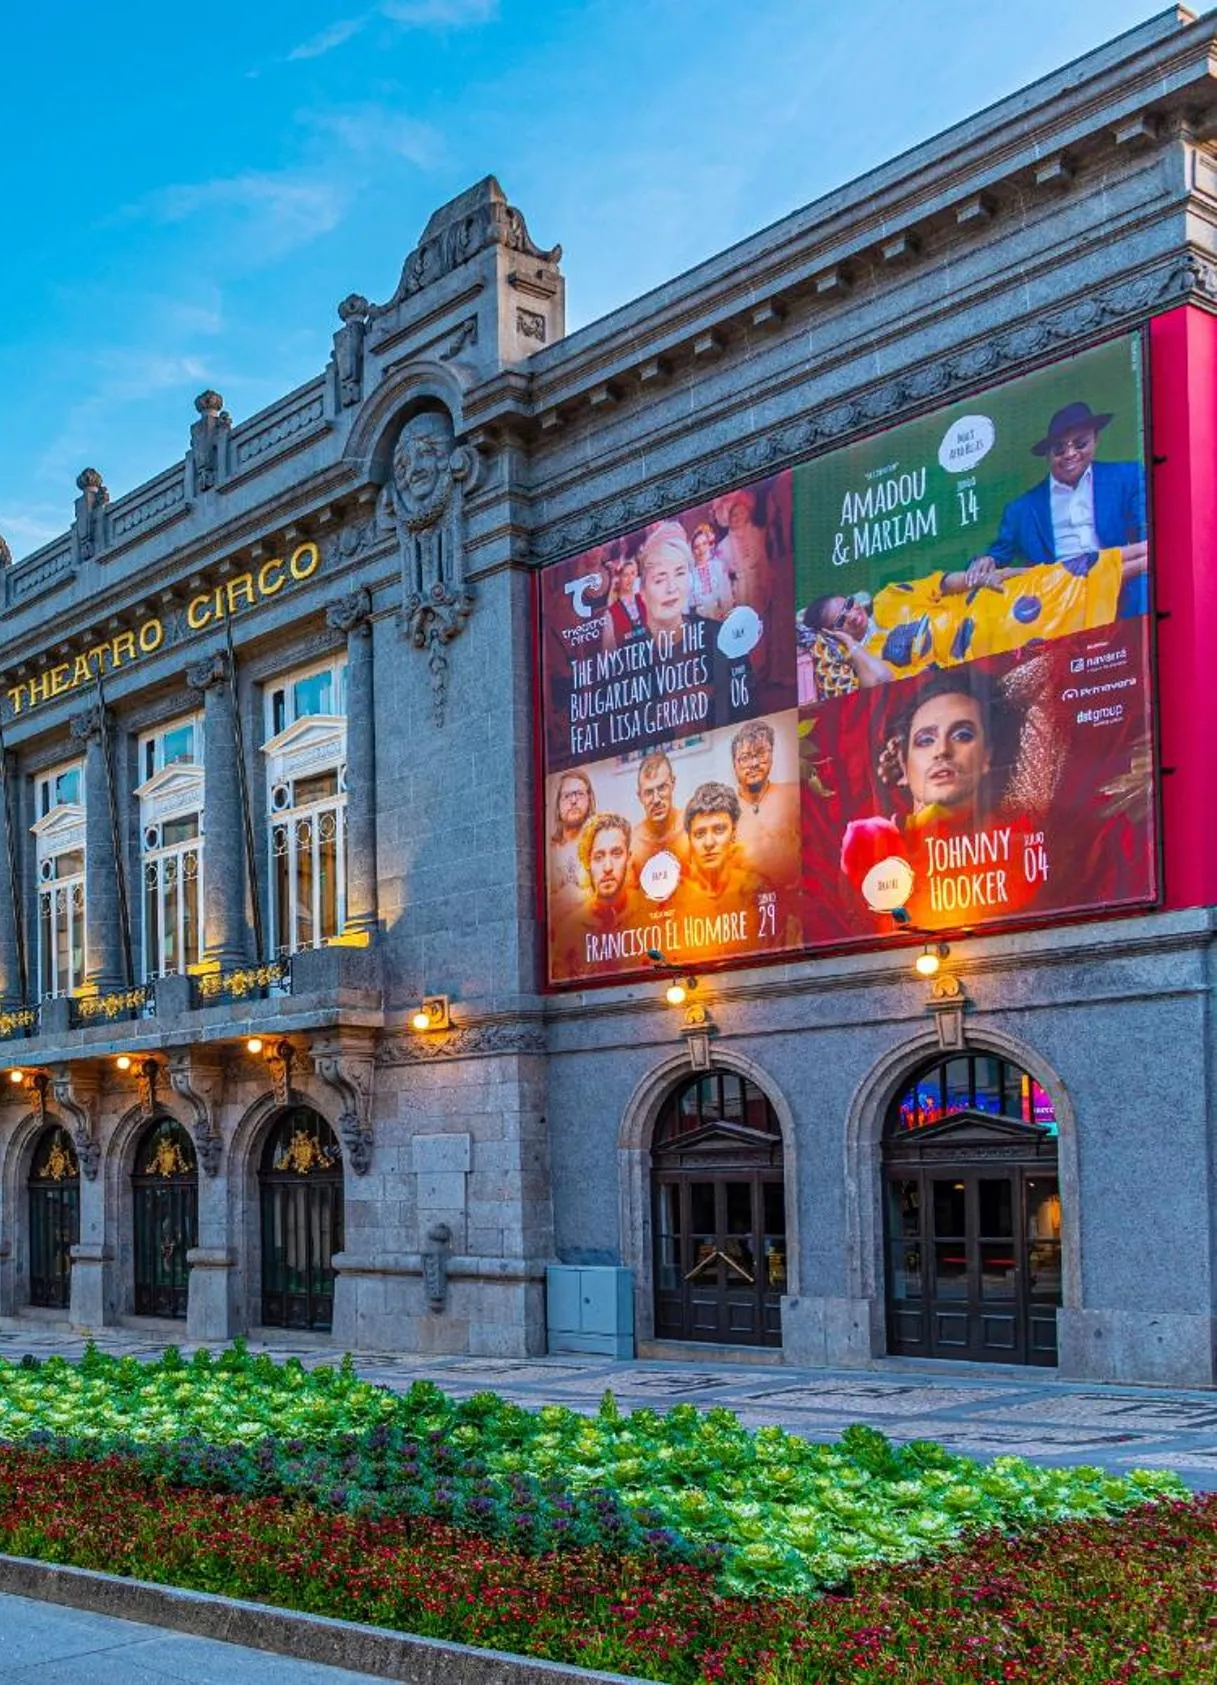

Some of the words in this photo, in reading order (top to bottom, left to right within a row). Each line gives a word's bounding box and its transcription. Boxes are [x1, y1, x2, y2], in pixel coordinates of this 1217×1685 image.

[840, 467, 926, 526] AMADOU
[957, 489, 980, 527] 14
[832, 533, 850, 566] &
[853, 503, 938, 560] MARIAM
[8, 618, 163, 714] THEATRO
[187, 542, 321, 629] CIRCO
[571, 659, 594, 690] THE
[597, 637, 654, 681] MYSTERY
[658, 630, 677, 662] OF
[680, 621, 706, 654] THE
[570, 673, 652, 723] BULGARIAN
[655, 655, 709, 696] VOICES
[731, 674, 750, 708] 06
[570, 722, 606, 755] FEAT.
[610, 710, 642, 744] LISA
[644, 691, 709, 734] GERRARD
[925, 828, 1011, 877] JOHNNY
[1024, 846, 1049, 883] 04
[930, 870, 1008, 913] HOOKER
[585, 924, 662, 963] FRANCISCO
[666, 919, 682, 951] EL
[684, 911, 749, 948] HOMBRE
[758, 903, 777, 938] 29
